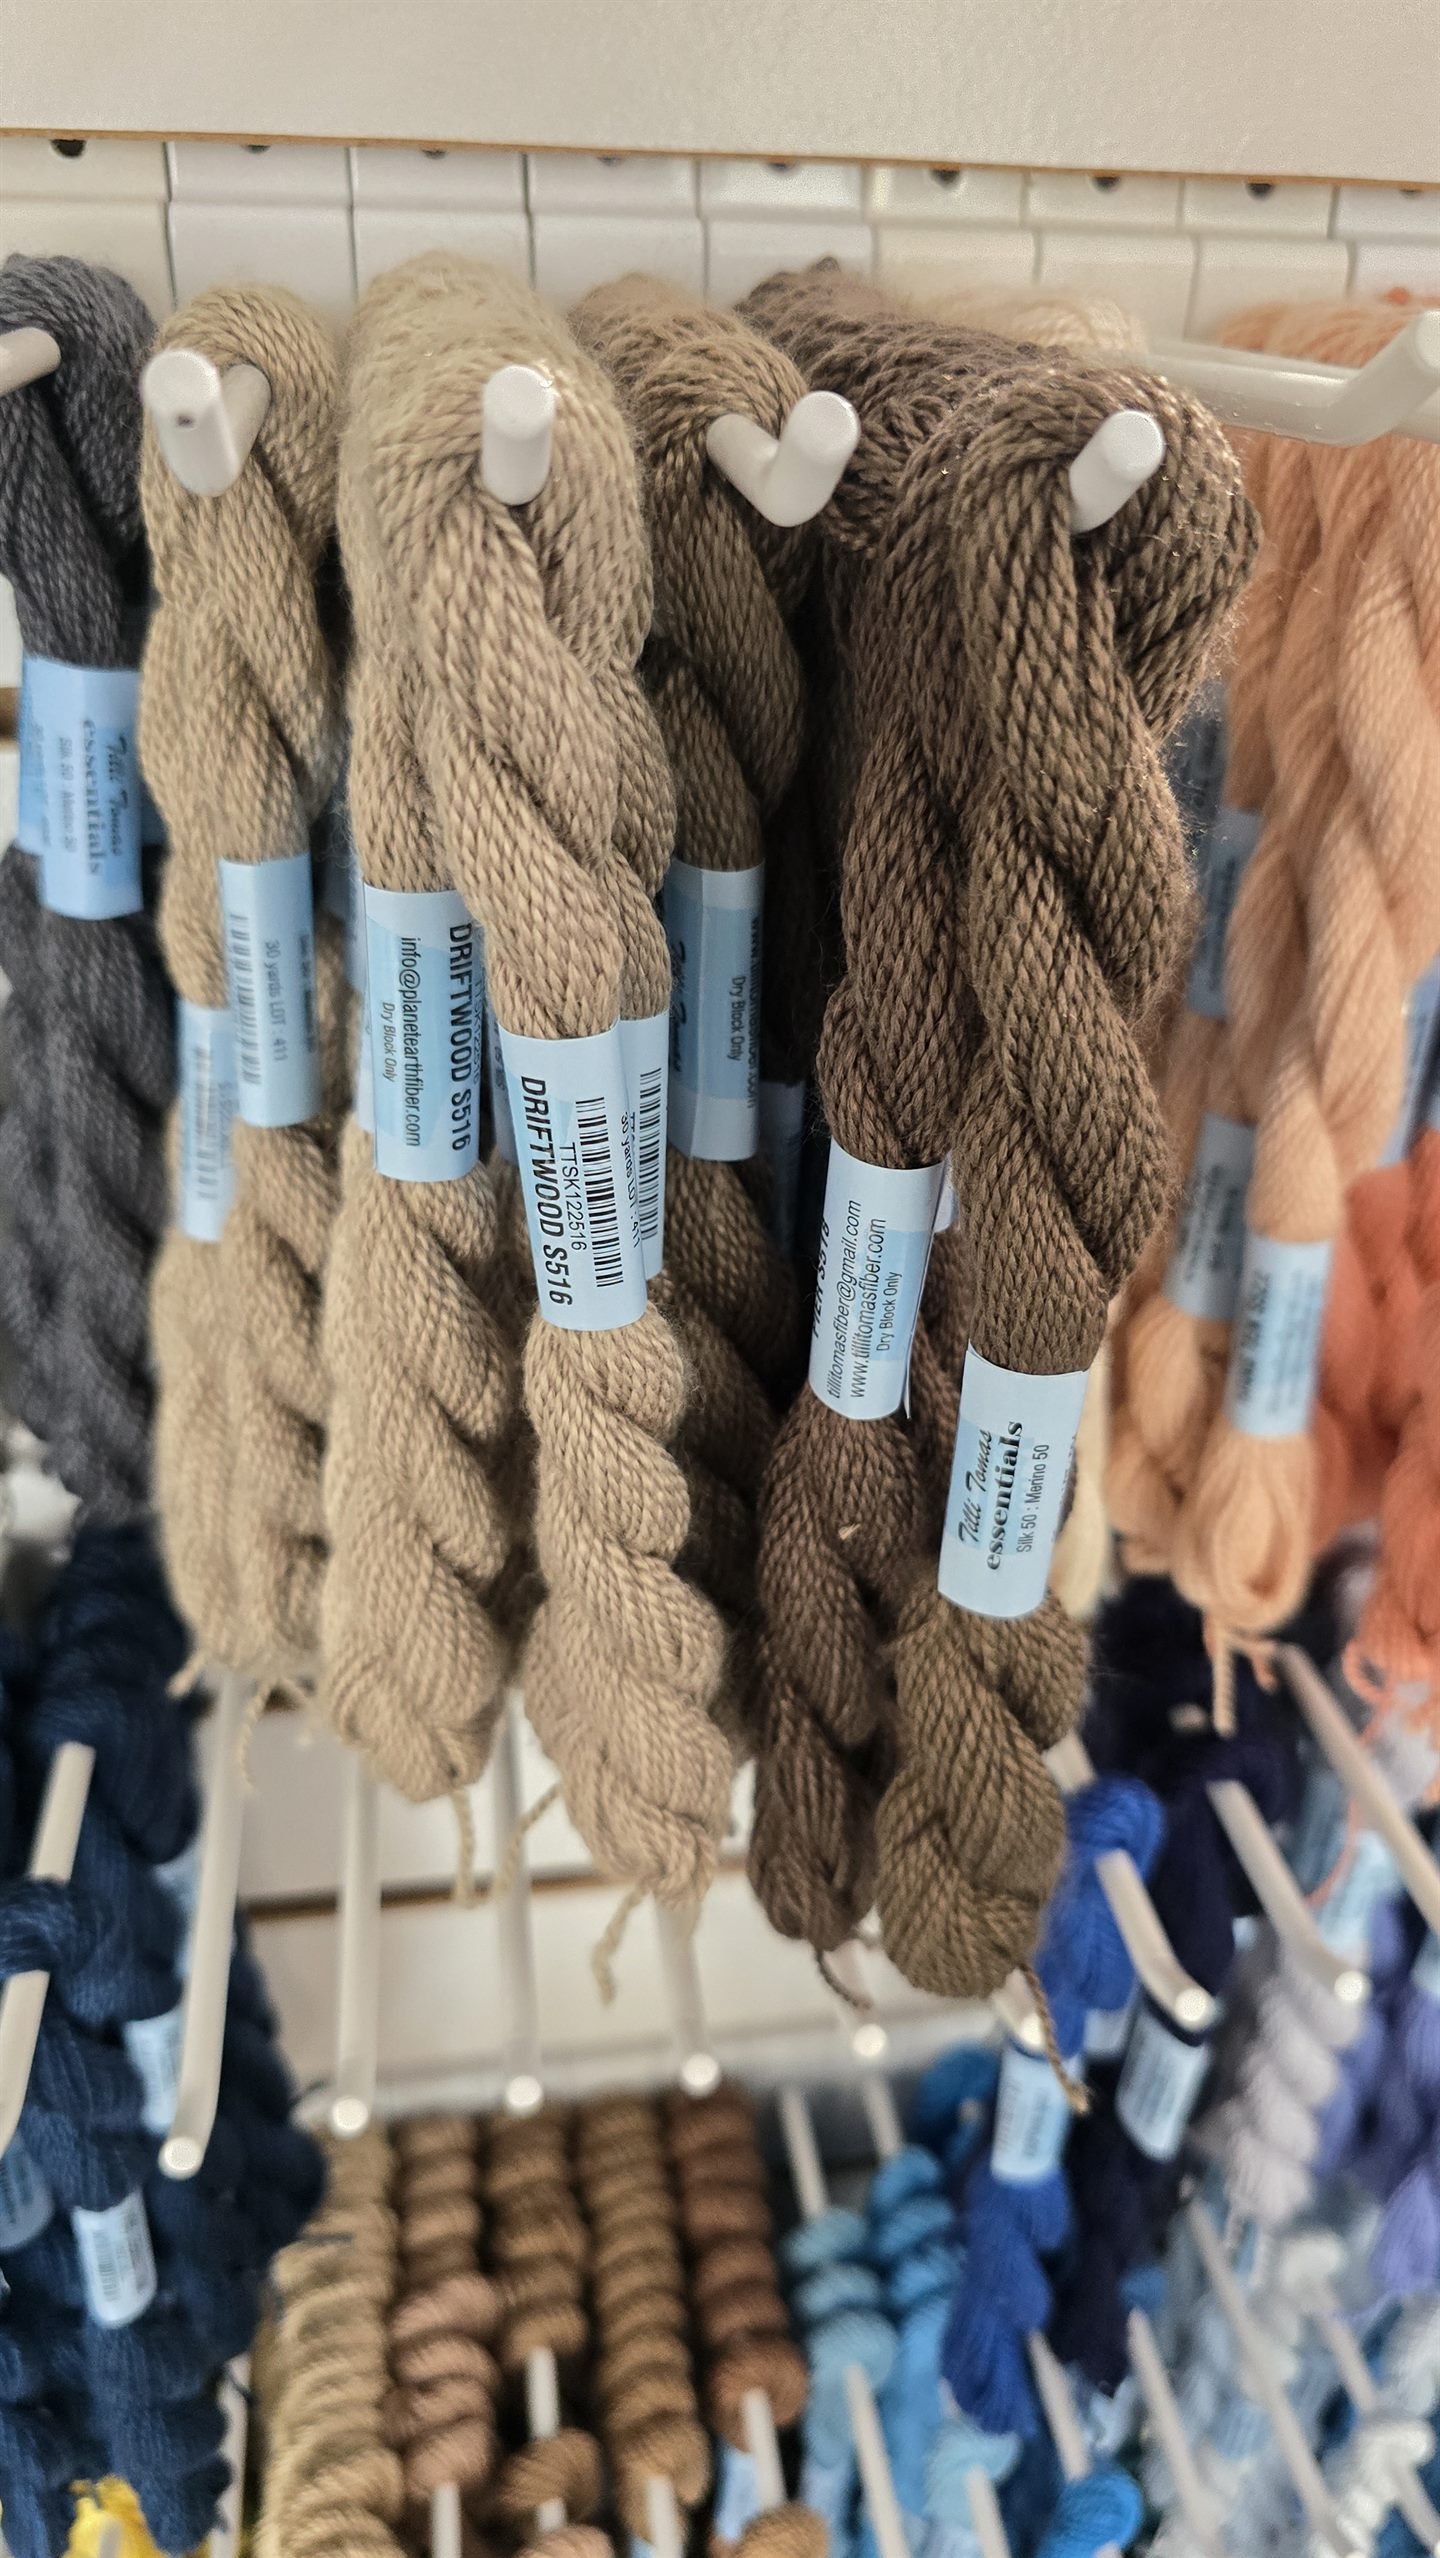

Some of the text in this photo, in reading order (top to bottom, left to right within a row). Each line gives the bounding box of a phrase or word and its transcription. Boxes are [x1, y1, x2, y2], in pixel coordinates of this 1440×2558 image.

[83, 719, 106, 875] essentials
[264, 939, 280, 959] 30
[265, 961, 282, 998] yards
[269, 1001, 286, 1029] LOT
[273, 1038, 289, 1063] 411
[382, 1001, 397, 1083] Dry Block Only
[399, 937, 421, 1147] info@planetearthfiber.com
[450, 922, 473, 1152] DRIFTWOOD S516
[726, 975, 746, 1062] Dry Block Only
[521, 1075, 573, 1306] DRIFTWOOD S516
[559, 1142, 587, 1251] TTSK122516
[621, 1137, 634, 1176] yards
[631, 1221, 641, 1249] 411
[826, 1200, 862, 1399] tillitomasfiber@gmail.com
[850, 1218, 886, 1398] www.tillitomasfiber.com
[876, 1271, 903, 1352] Dry Block Only
[957, 1429, 993, 1543] Tilli Tomas
[986, 1420, 1023, 1571] essentials
[1027, 1464, 1046, 1502] Merino
[1032, 1443, 1050, 1464] 50
[1016, 1529, 1033, 1553] Silk
[1025, 1512, 1037, 1530] 50
